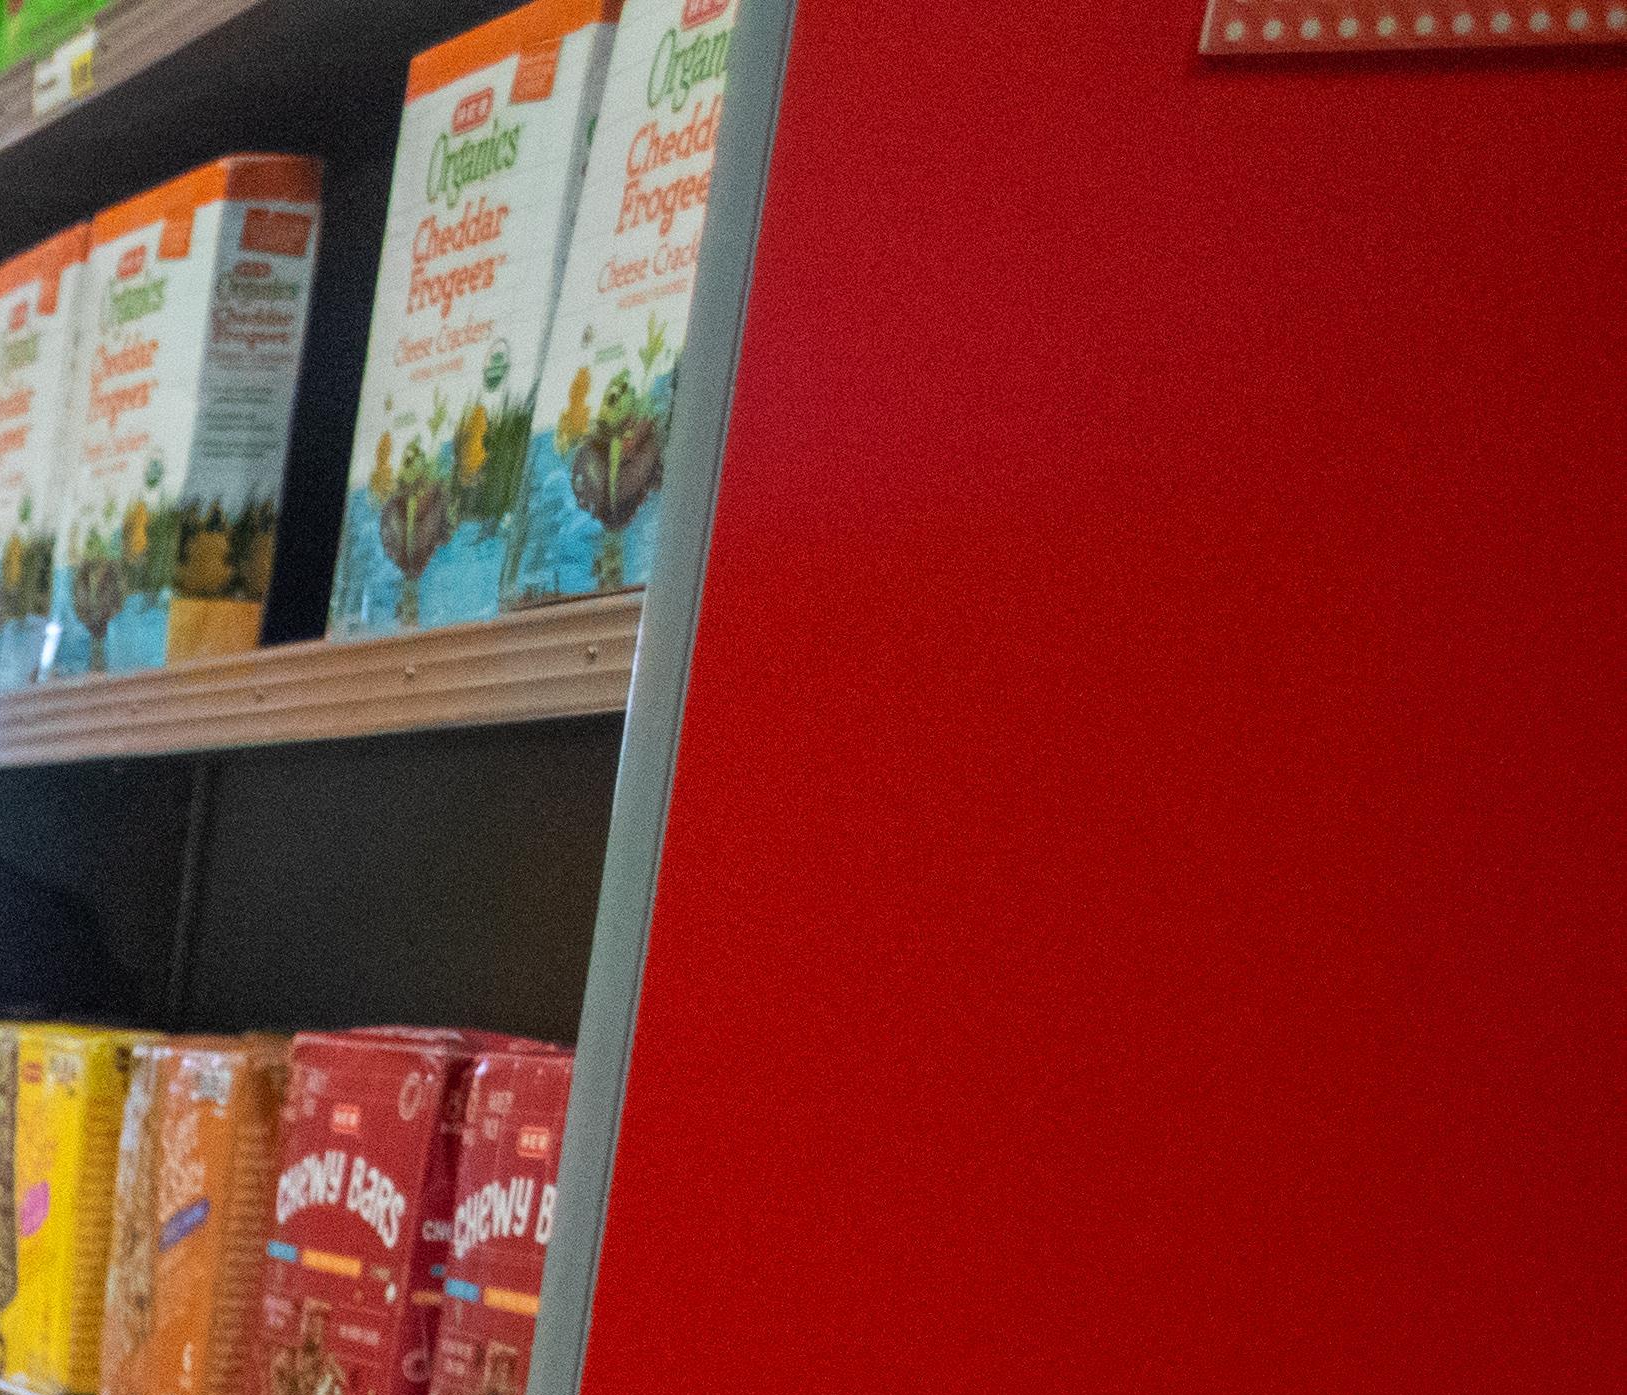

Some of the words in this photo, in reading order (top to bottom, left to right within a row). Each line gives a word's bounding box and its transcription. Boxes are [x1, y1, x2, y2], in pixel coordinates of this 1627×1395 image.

[648, 26, 730, 112] Organ
[427, 118, 524, 209] Organics
[624, 94, 722, 178] Chedd
[413, 196, 510, 265] Cheddar
[614, 168, 711, 238] Frogee
[652, 230, 700, 279] Crack
